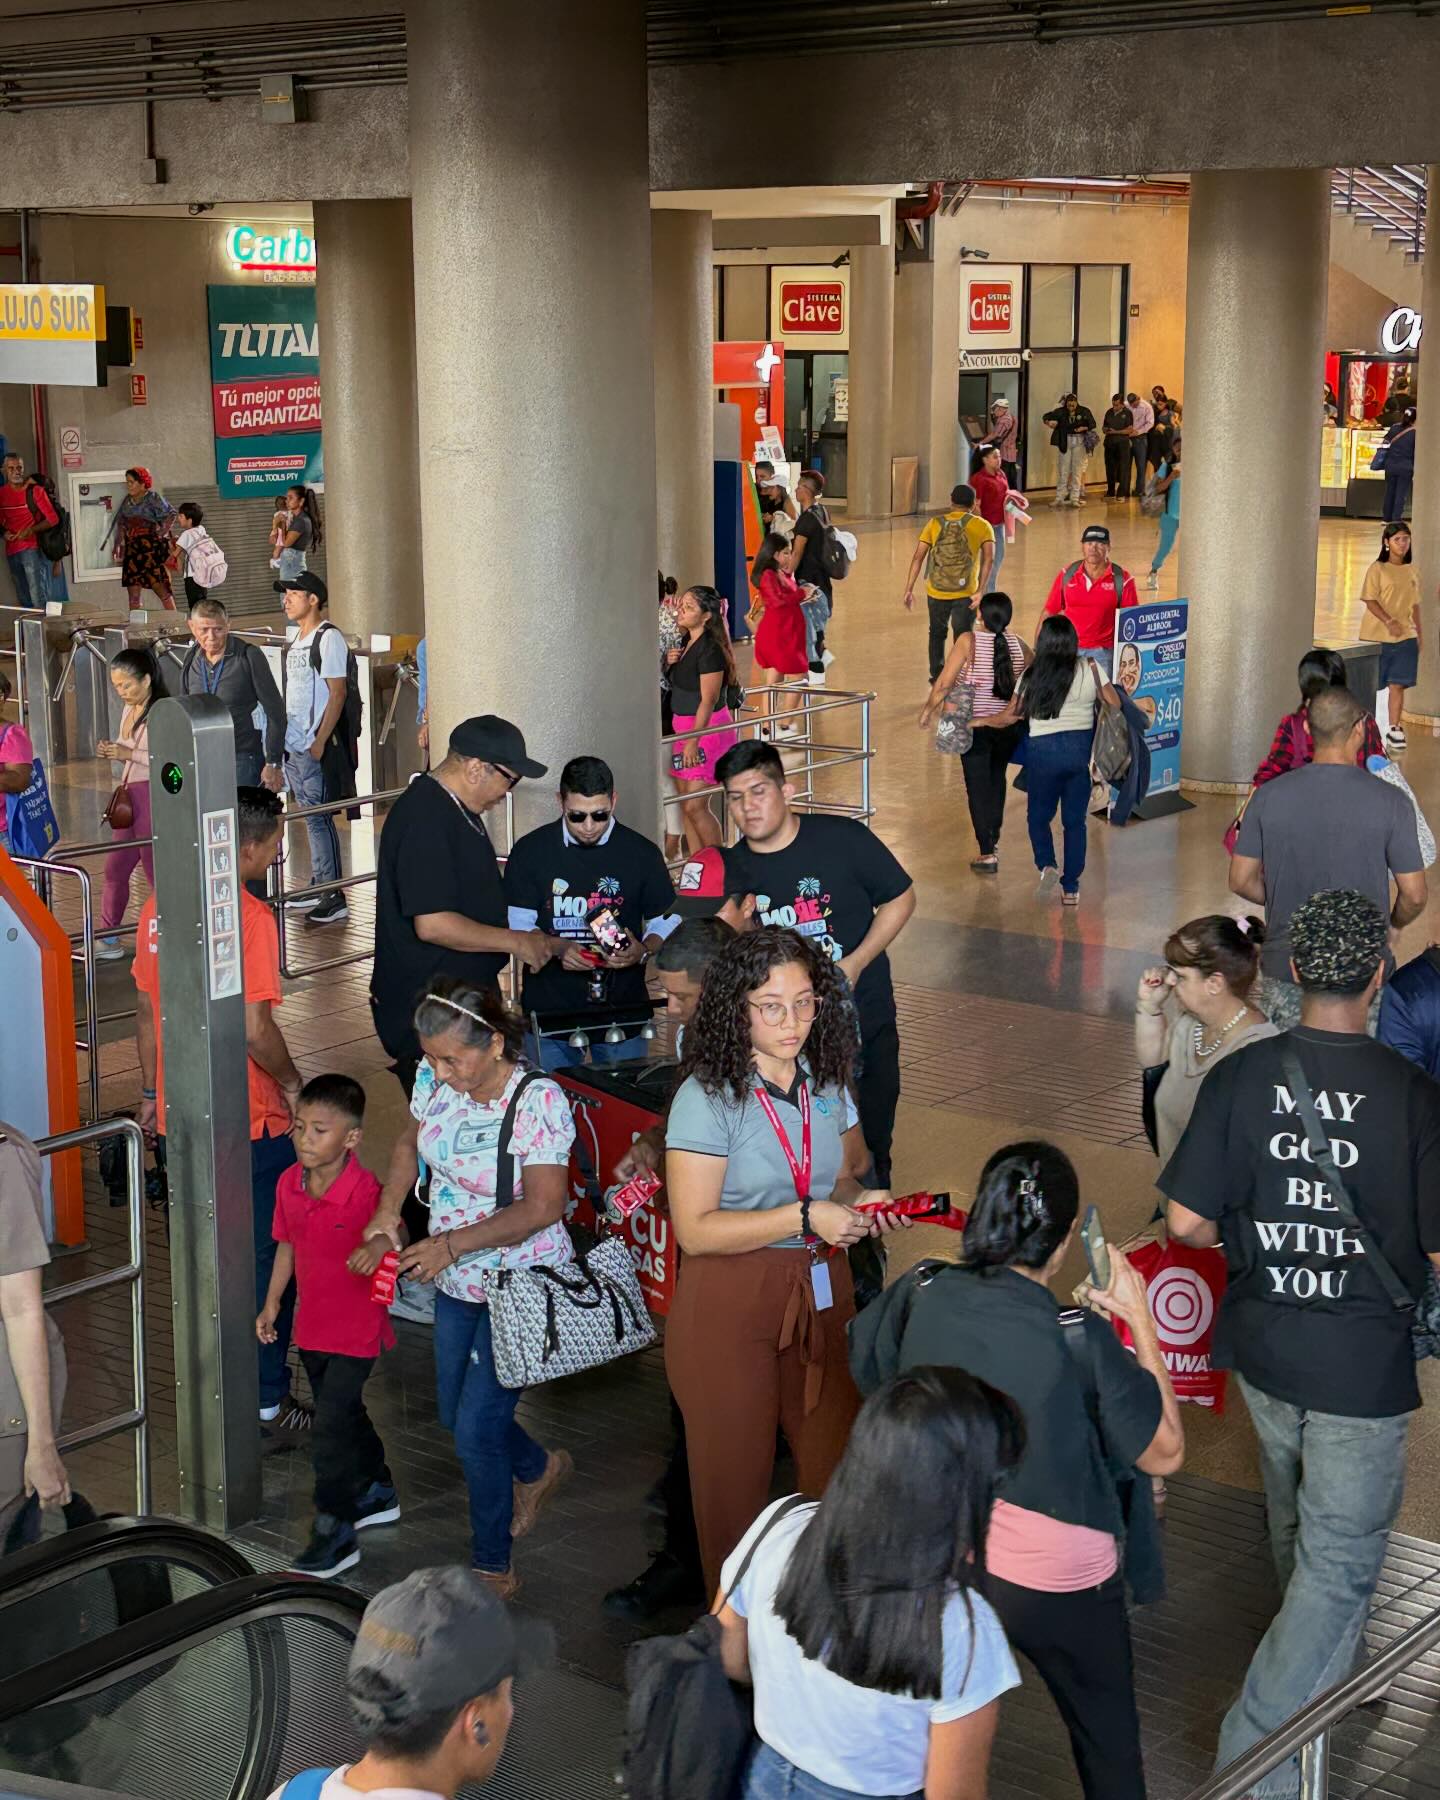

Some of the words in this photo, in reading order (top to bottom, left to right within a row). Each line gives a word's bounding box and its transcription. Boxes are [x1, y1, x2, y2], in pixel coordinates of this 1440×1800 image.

[0, 295, 44, 330] UJO
[50, 295, 90, 331] SUR
[783, 297, 841, 322] Clave
[970, 296, 1010, 321] Clave
[220, 389, 237, 407] Tú
[242, 386, 285, 406] mejor
[244, 474, 264, 483] TOTAL
[265, 473, 286, 482] TOOLS
[1157, 697, 1181, 726] $40
[1271, 1084, 1366, 1123] MAY
[1285, 1177, 1340, 1212] BE
[1254, 1220, 1366, 1258] WITH
[1266, 1266, 1349, 1299] YOU
